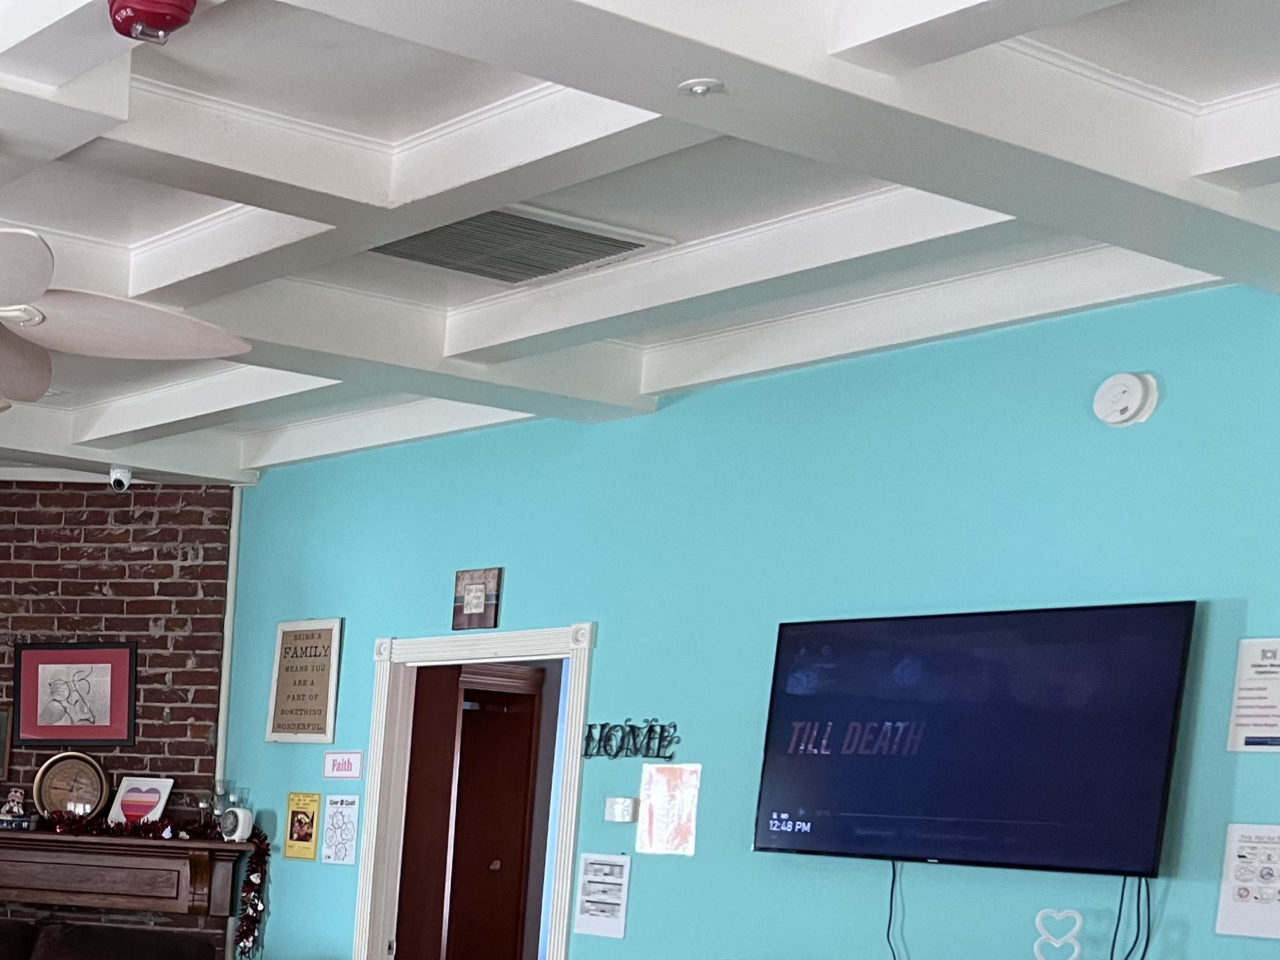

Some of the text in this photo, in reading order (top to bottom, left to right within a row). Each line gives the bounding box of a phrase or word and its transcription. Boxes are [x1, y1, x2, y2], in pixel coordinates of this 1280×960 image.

[115, 8, 134, 22] FIRE
[293, 633, 315, 641] BEING
[283, 645, 331, 659] FAMILY
[284, 663, 326, 673] MEANS YOU
[292, 679, 307, 687] ARE
[286, 694, 307, 702] PART
[280, 708, 323, 716] SOMETHING
[583, 718, 680, 761] HOME
[787, 721, 926, 755] TILL DEATH
[332, 758, 353, 772] Faith
[769, 820, 811, 833] 12:48 PM
